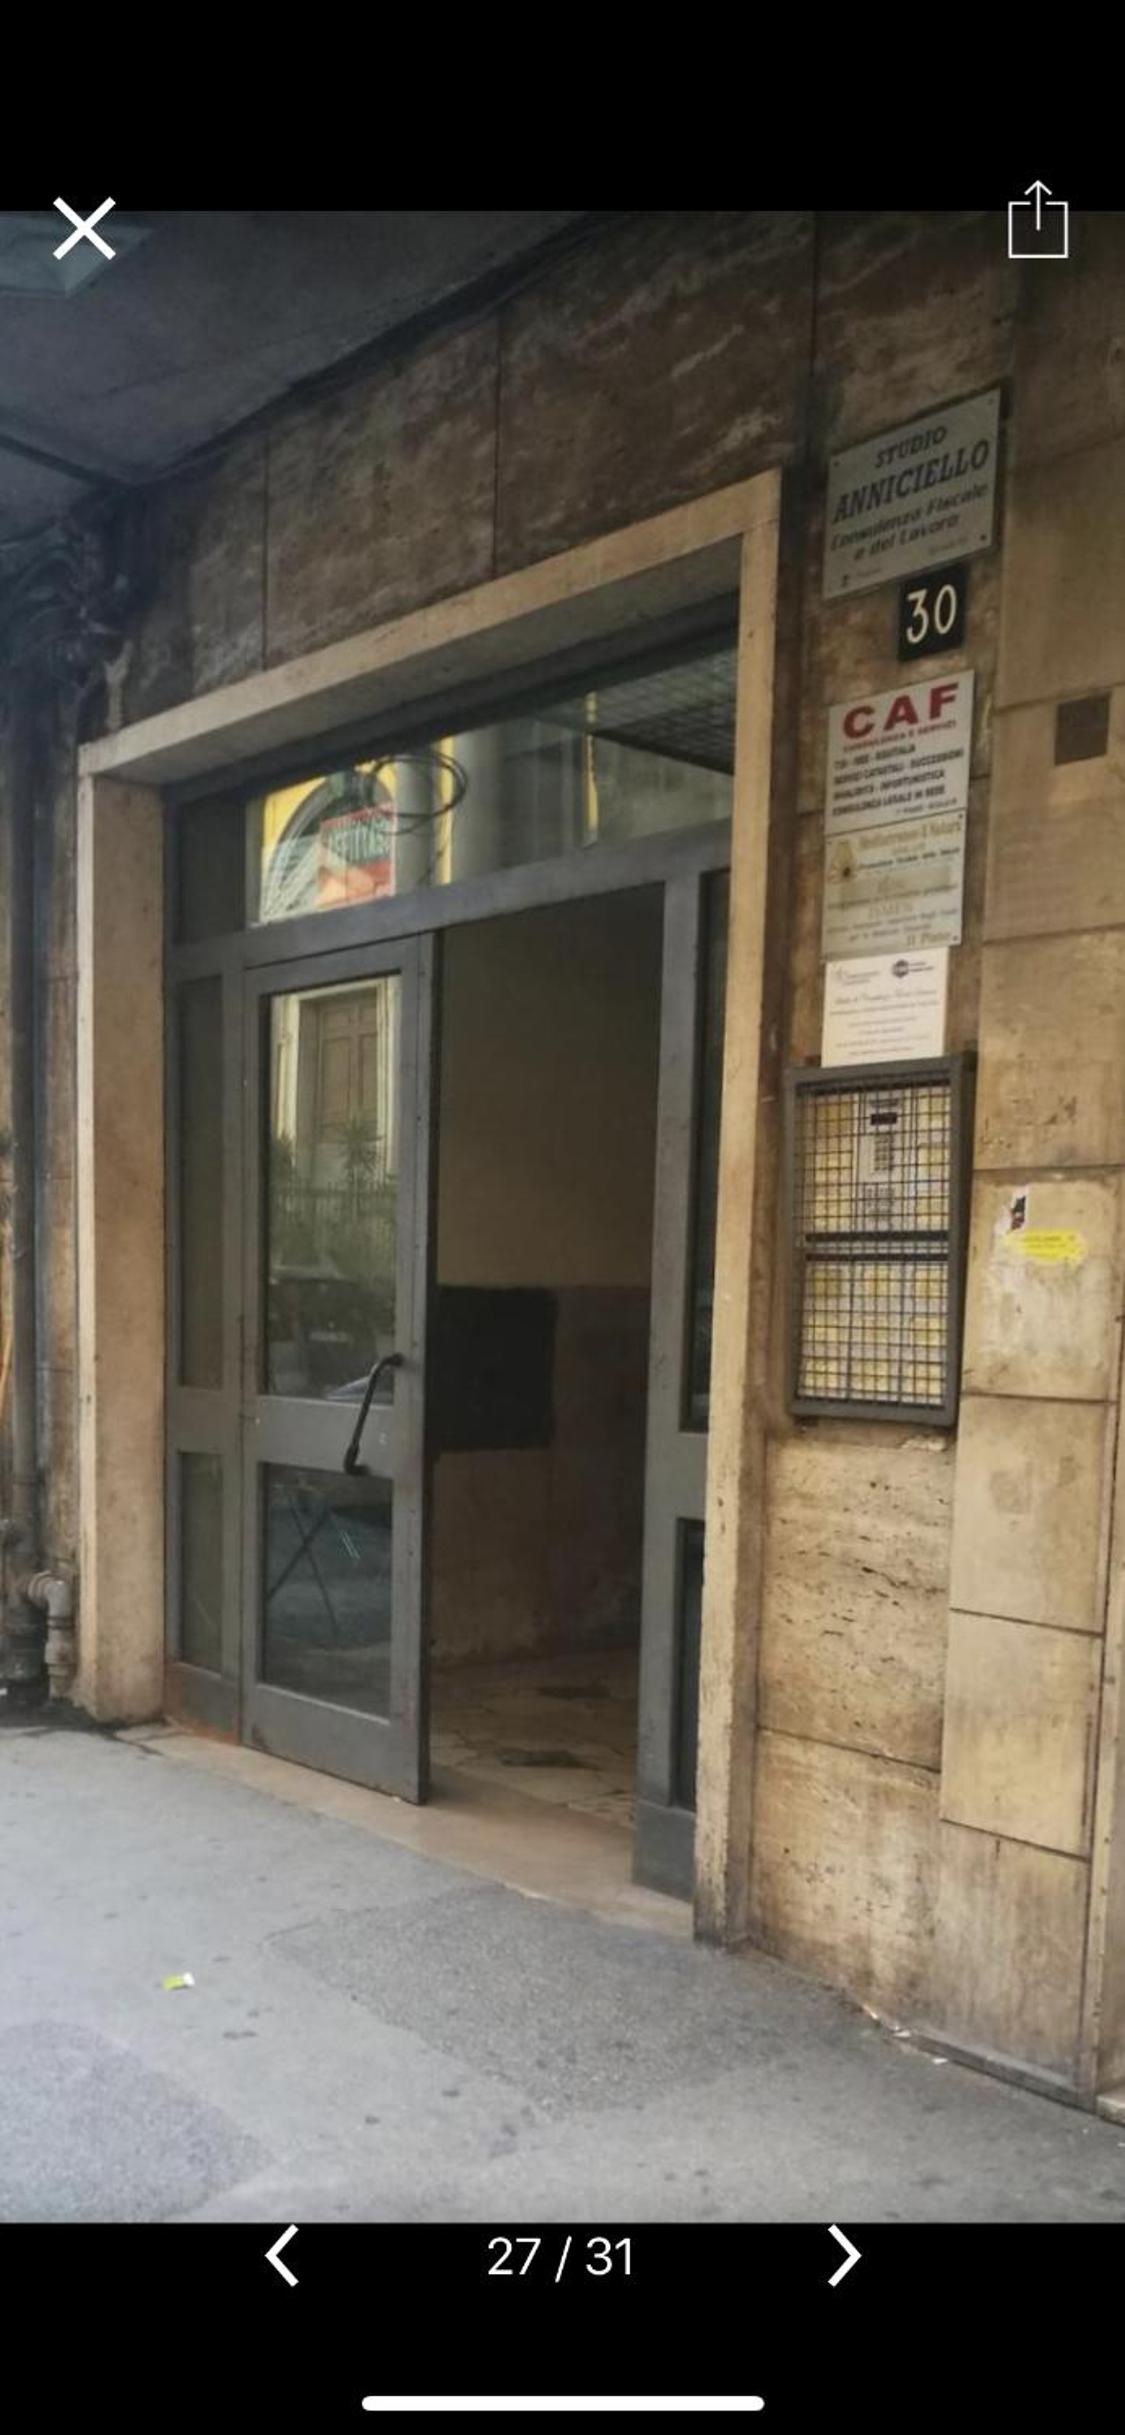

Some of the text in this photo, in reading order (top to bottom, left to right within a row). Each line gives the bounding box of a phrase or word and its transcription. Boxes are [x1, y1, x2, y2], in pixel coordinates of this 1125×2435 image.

[875, 425, 947, 468] STUDIO
[832, 439, 989, 524] ANNICIELLO
[906, 584, 957, 643] 30
[843, 682, 959, 739] CAF
